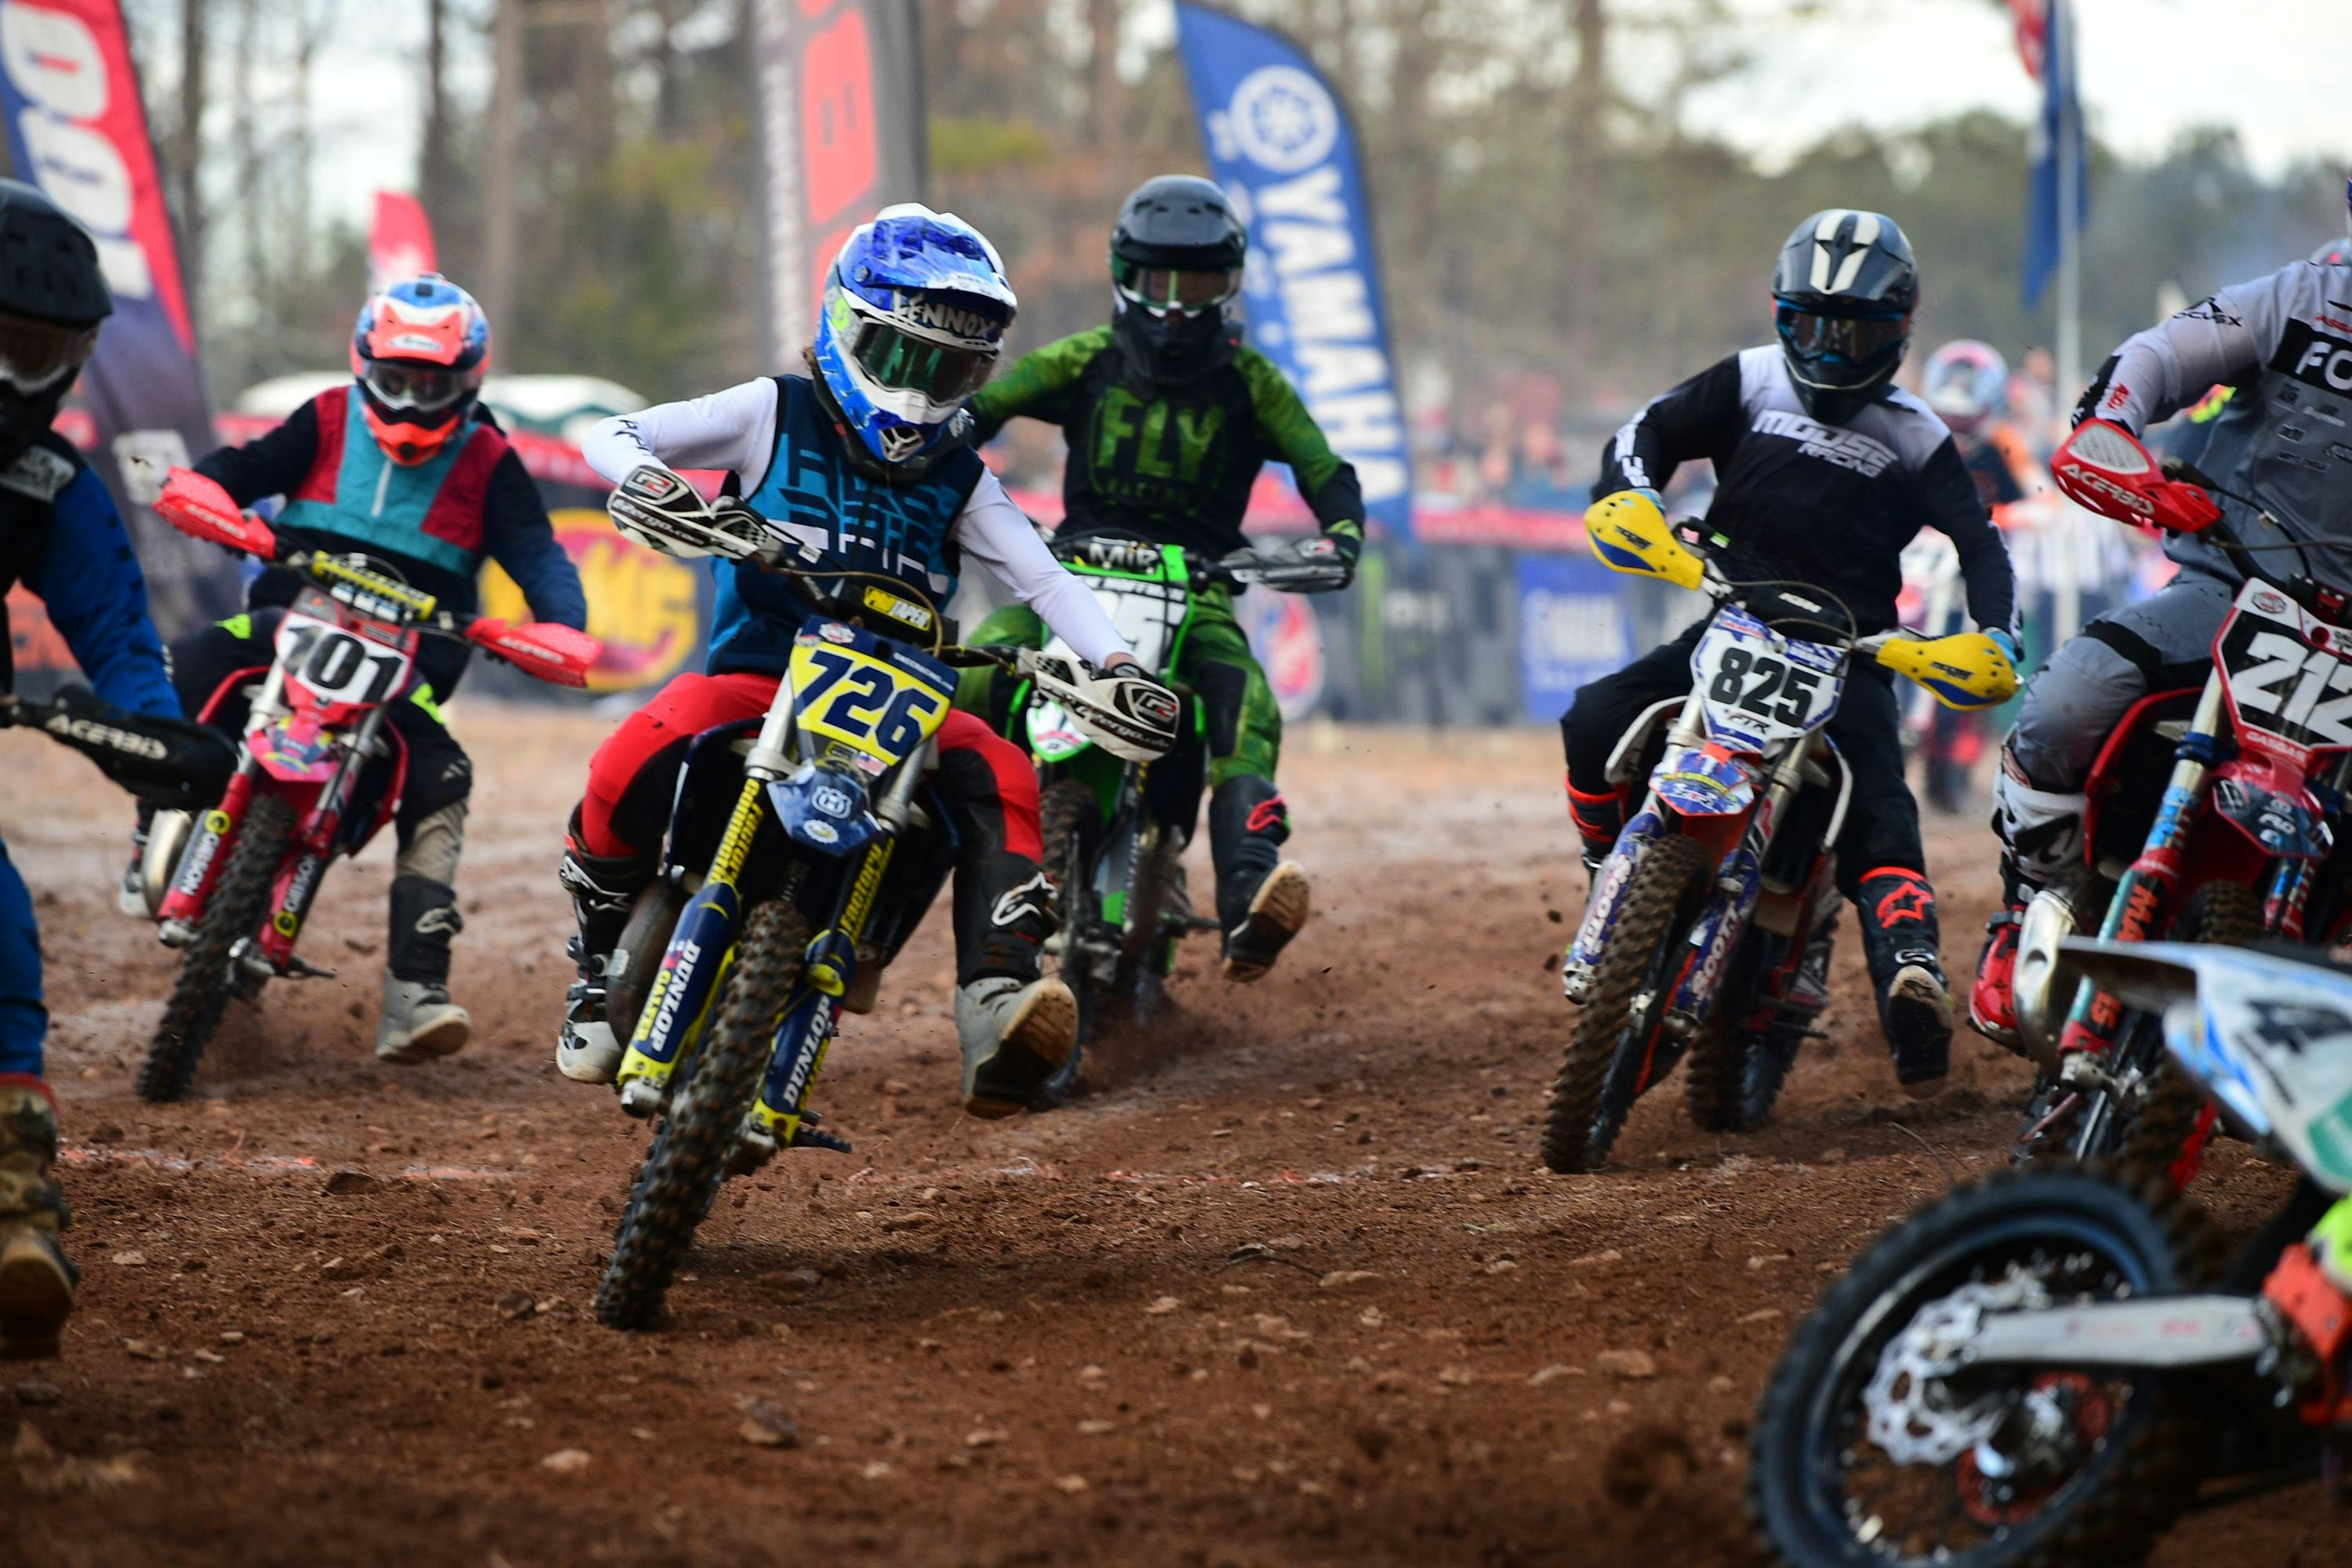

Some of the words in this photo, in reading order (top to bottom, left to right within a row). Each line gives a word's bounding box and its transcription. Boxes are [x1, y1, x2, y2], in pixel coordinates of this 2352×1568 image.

[893, 287, 998, 340] LENNOX
[1097, 387, 1226, 483] FLY
[1751, 408, 1899, 470] MOOSE
[1797, 441, 1882, 478] RACING
[796, 650, 939, 757] 726
[1710, 647, 1820, 728] 825
[649, 939, 702, 1052] DUNLOP
[784, 994, 831, 1108] DUNLOP
